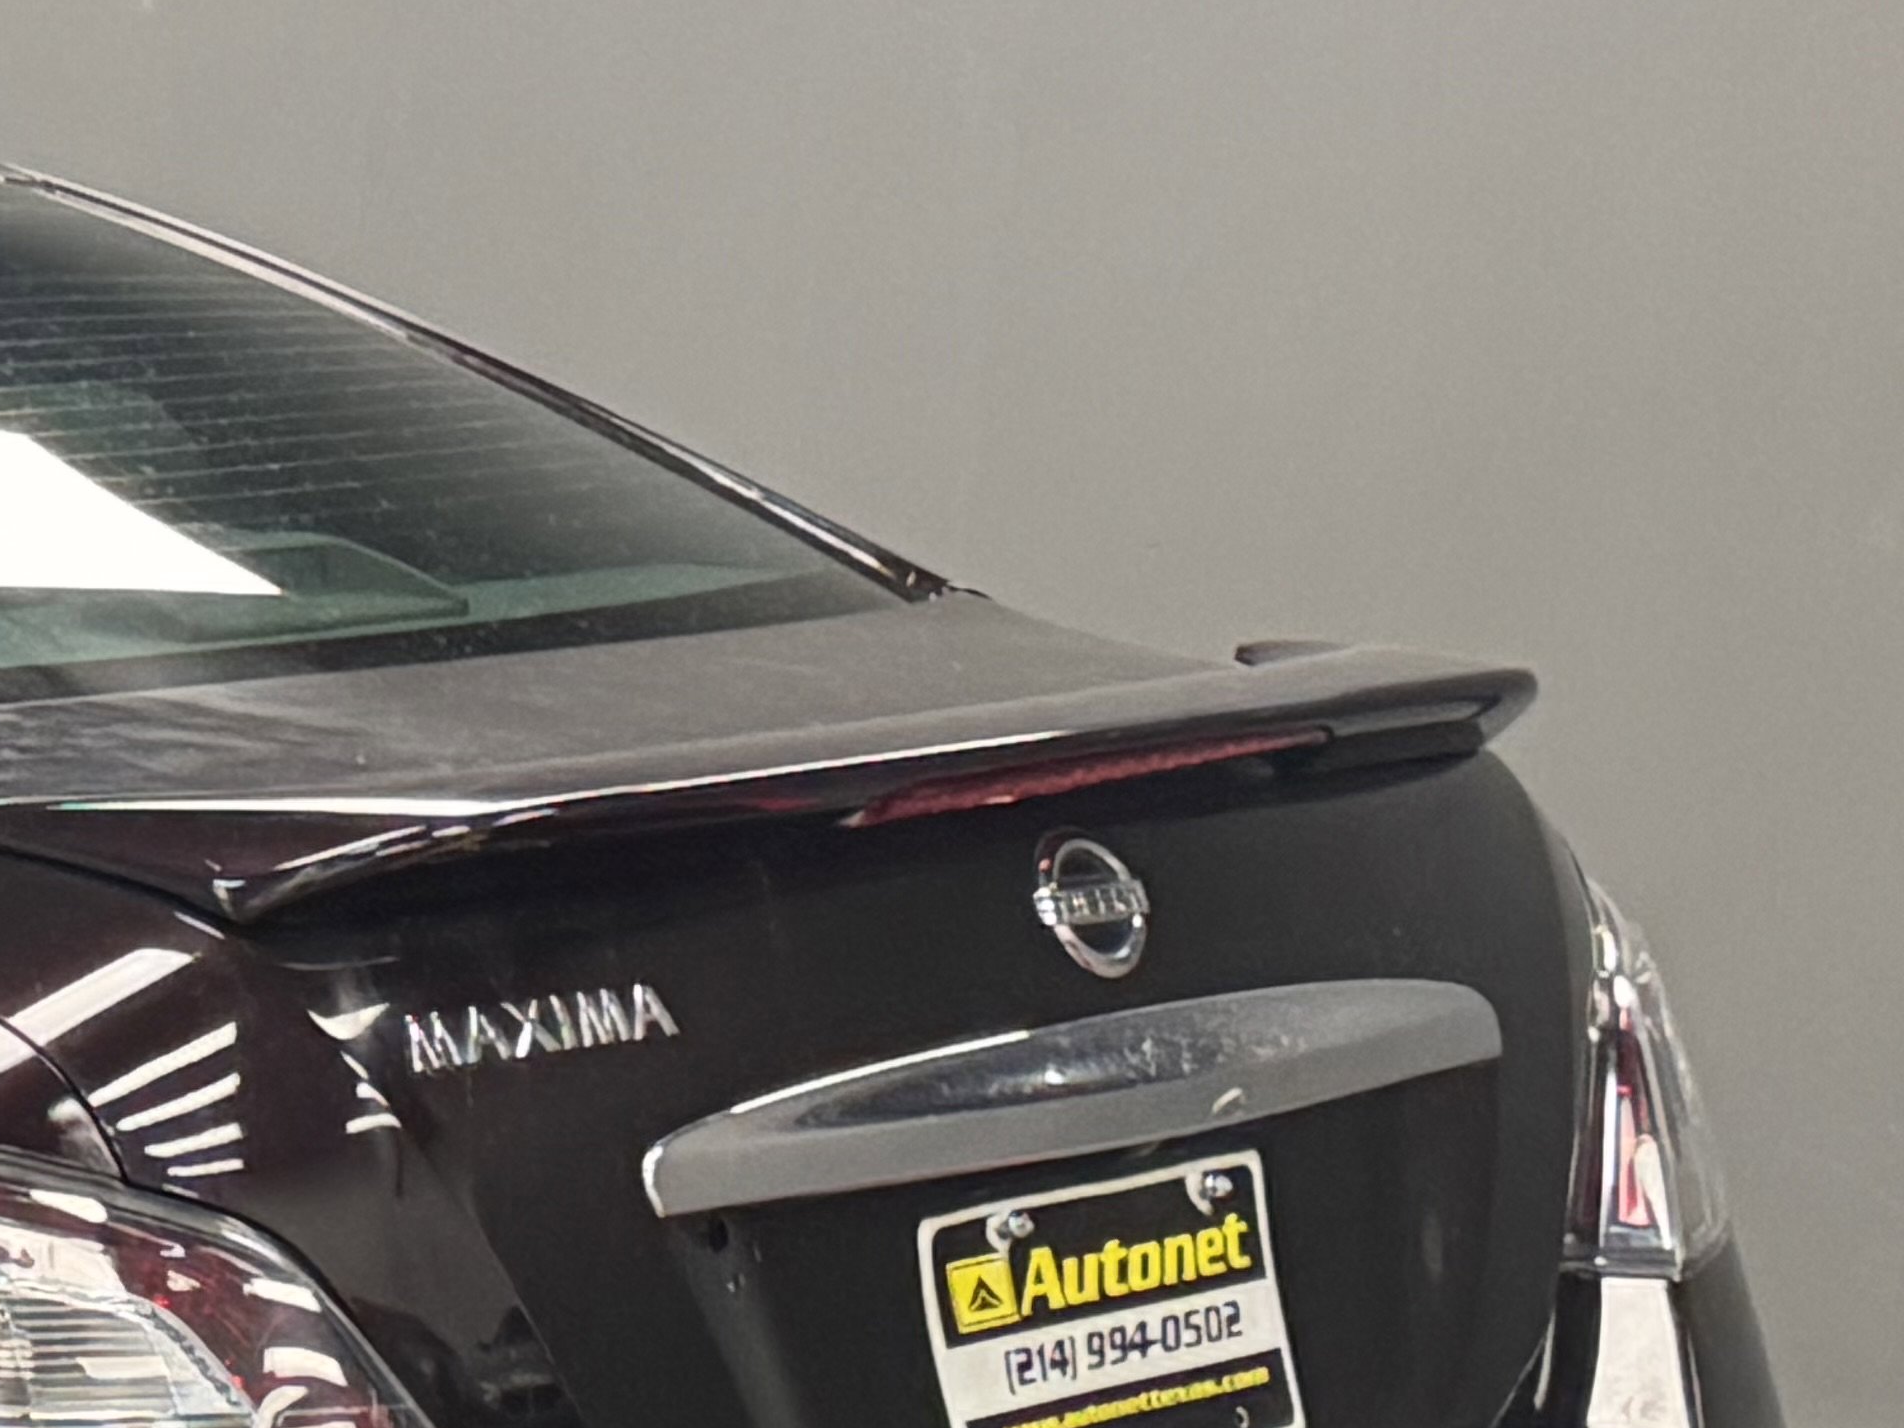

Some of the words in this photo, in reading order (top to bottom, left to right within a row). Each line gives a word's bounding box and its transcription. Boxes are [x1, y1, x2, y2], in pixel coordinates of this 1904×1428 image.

[403, 982, 680, 1073] MAXIMA
[1021, 1212, 1252, 1317] Autonet
[1004, 1335, 1077, 1396] (214)
[1087, 1300, 1243, 1370] 994-0502
